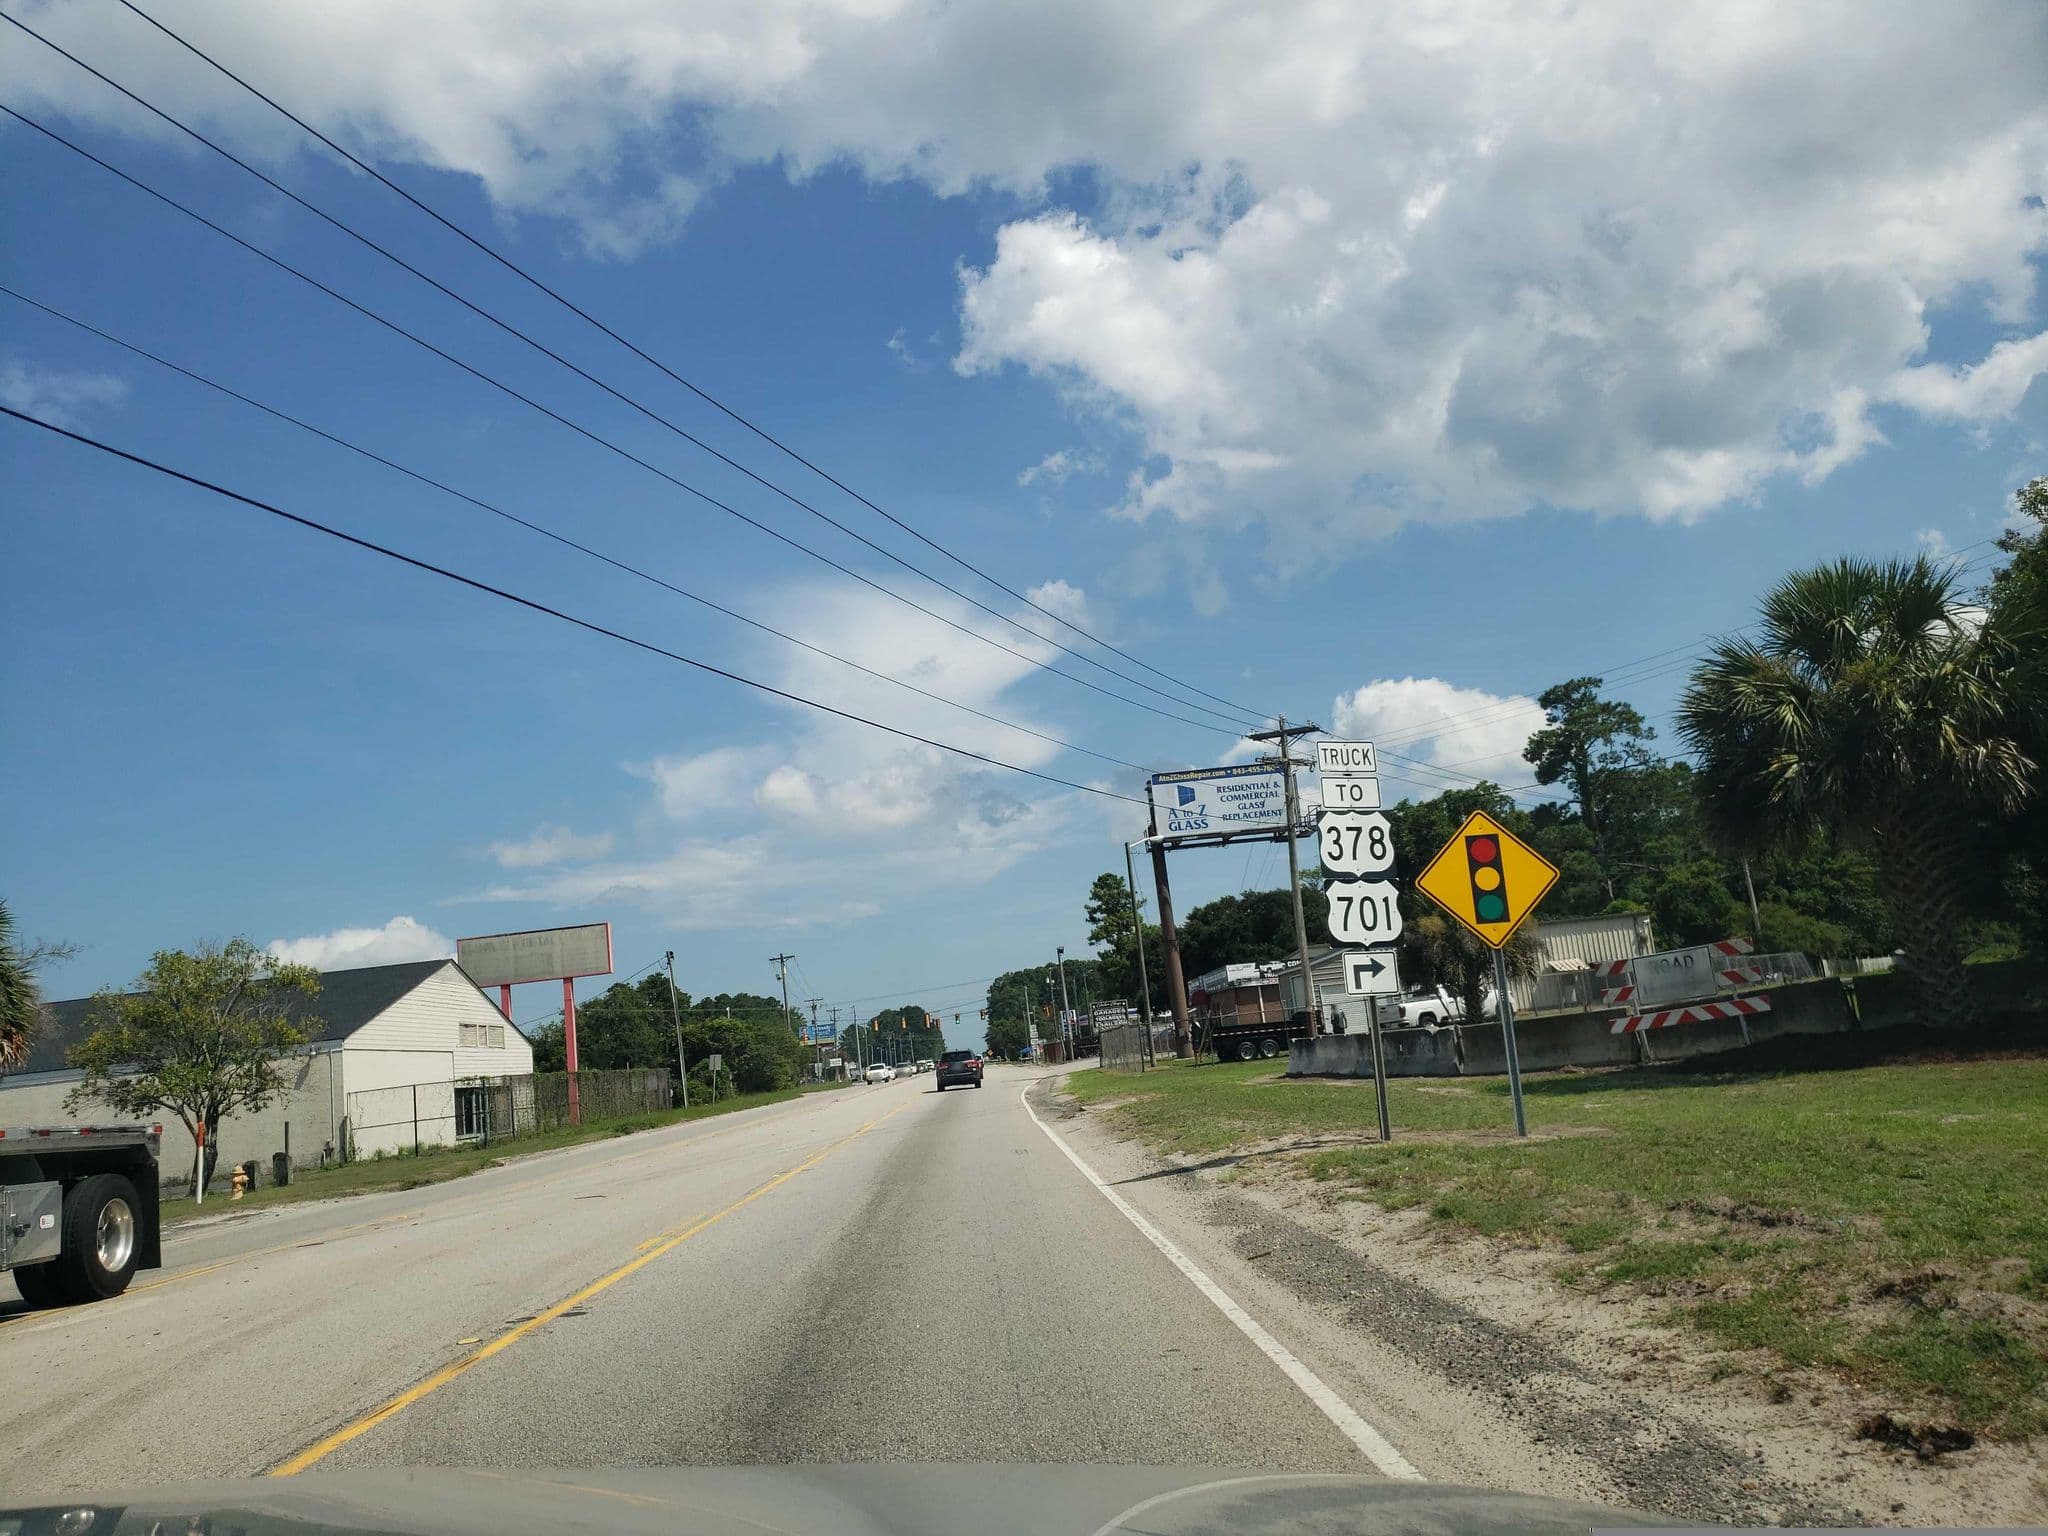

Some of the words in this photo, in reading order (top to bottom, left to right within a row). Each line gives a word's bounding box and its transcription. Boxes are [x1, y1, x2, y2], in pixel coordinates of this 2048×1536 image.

[1321, 748, 1372, 766] TRUCK
[1216, 782, 1271, 794] RESIDENTIAL
[1273, 781, 1280, 789] &
[1335, 784, 1363, 802] TO
[1220, 790, 1280, 802] COMMERCIAL
[1168, 807, 1178, 819] A
[1183, 810, 1193, 818] to
[1198, 804, 1207, 817] Z
[1237, 800, 1265, 810] GLASS
[1222, 808, 1283, 821] REPLACEMENT
[1168, 818, 1209, 831] GLASS
[1326, 826, 1387, 861] 378
[1337, 896, 1392, 931] 701
